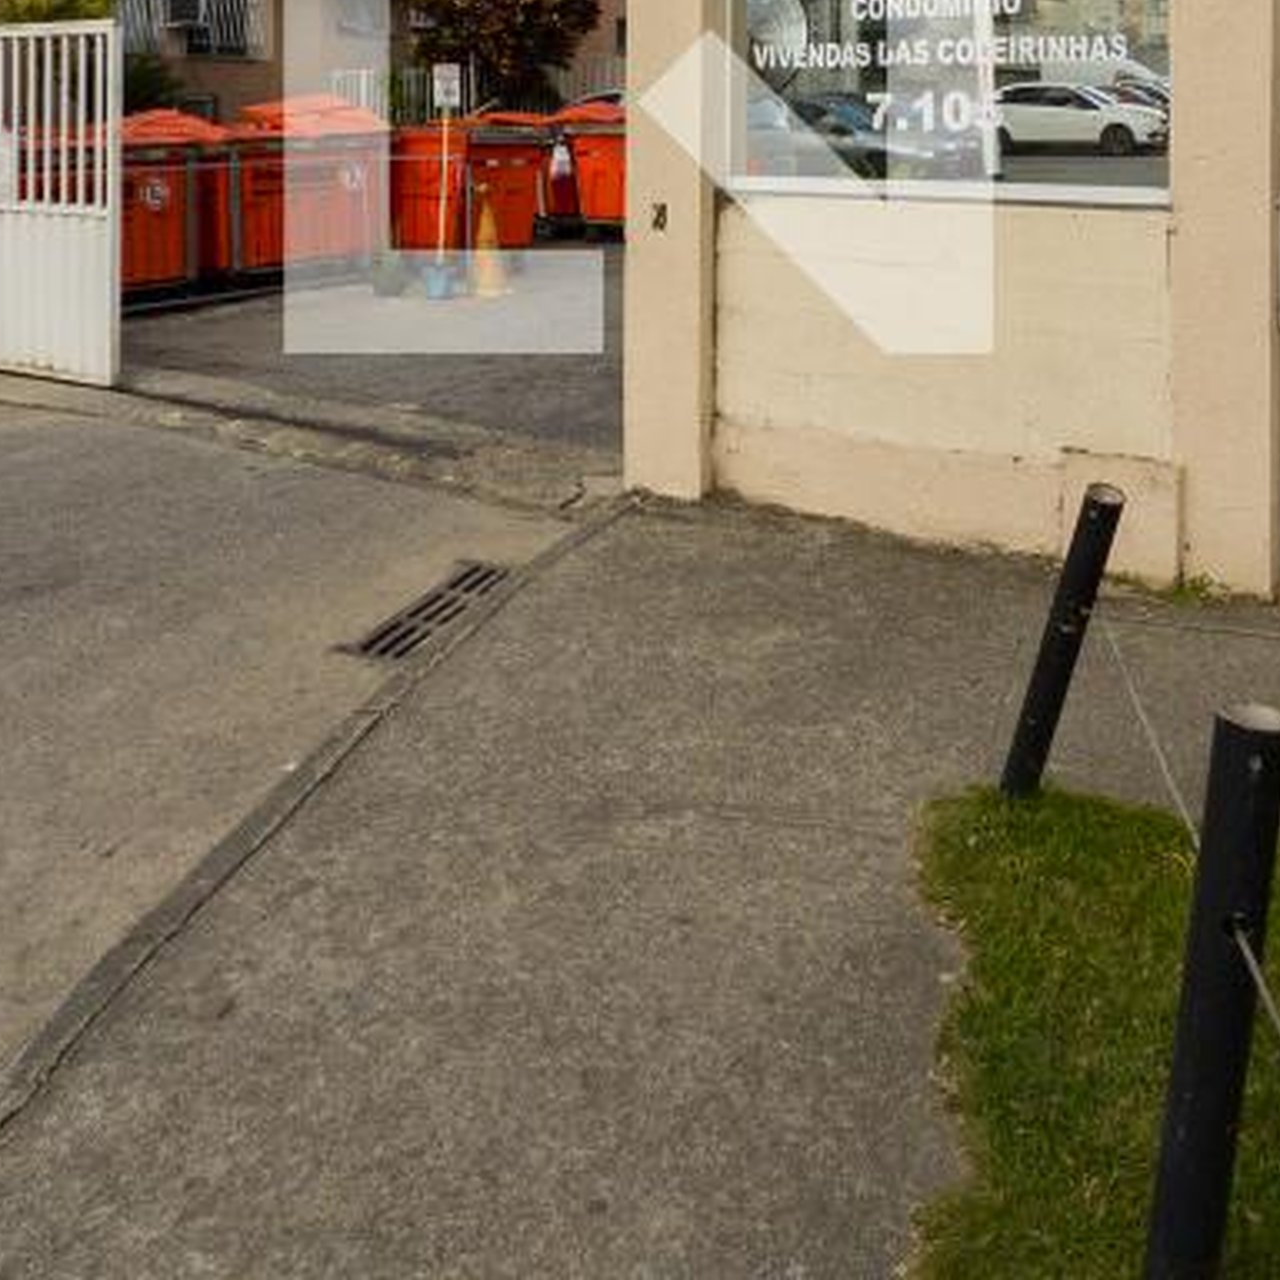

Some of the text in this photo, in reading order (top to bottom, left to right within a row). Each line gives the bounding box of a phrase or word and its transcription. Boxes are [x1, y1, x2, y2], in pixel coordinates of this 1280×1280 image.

[753, 33, 1128, 70] VIVENDAS DAS COLEIRINHAS
